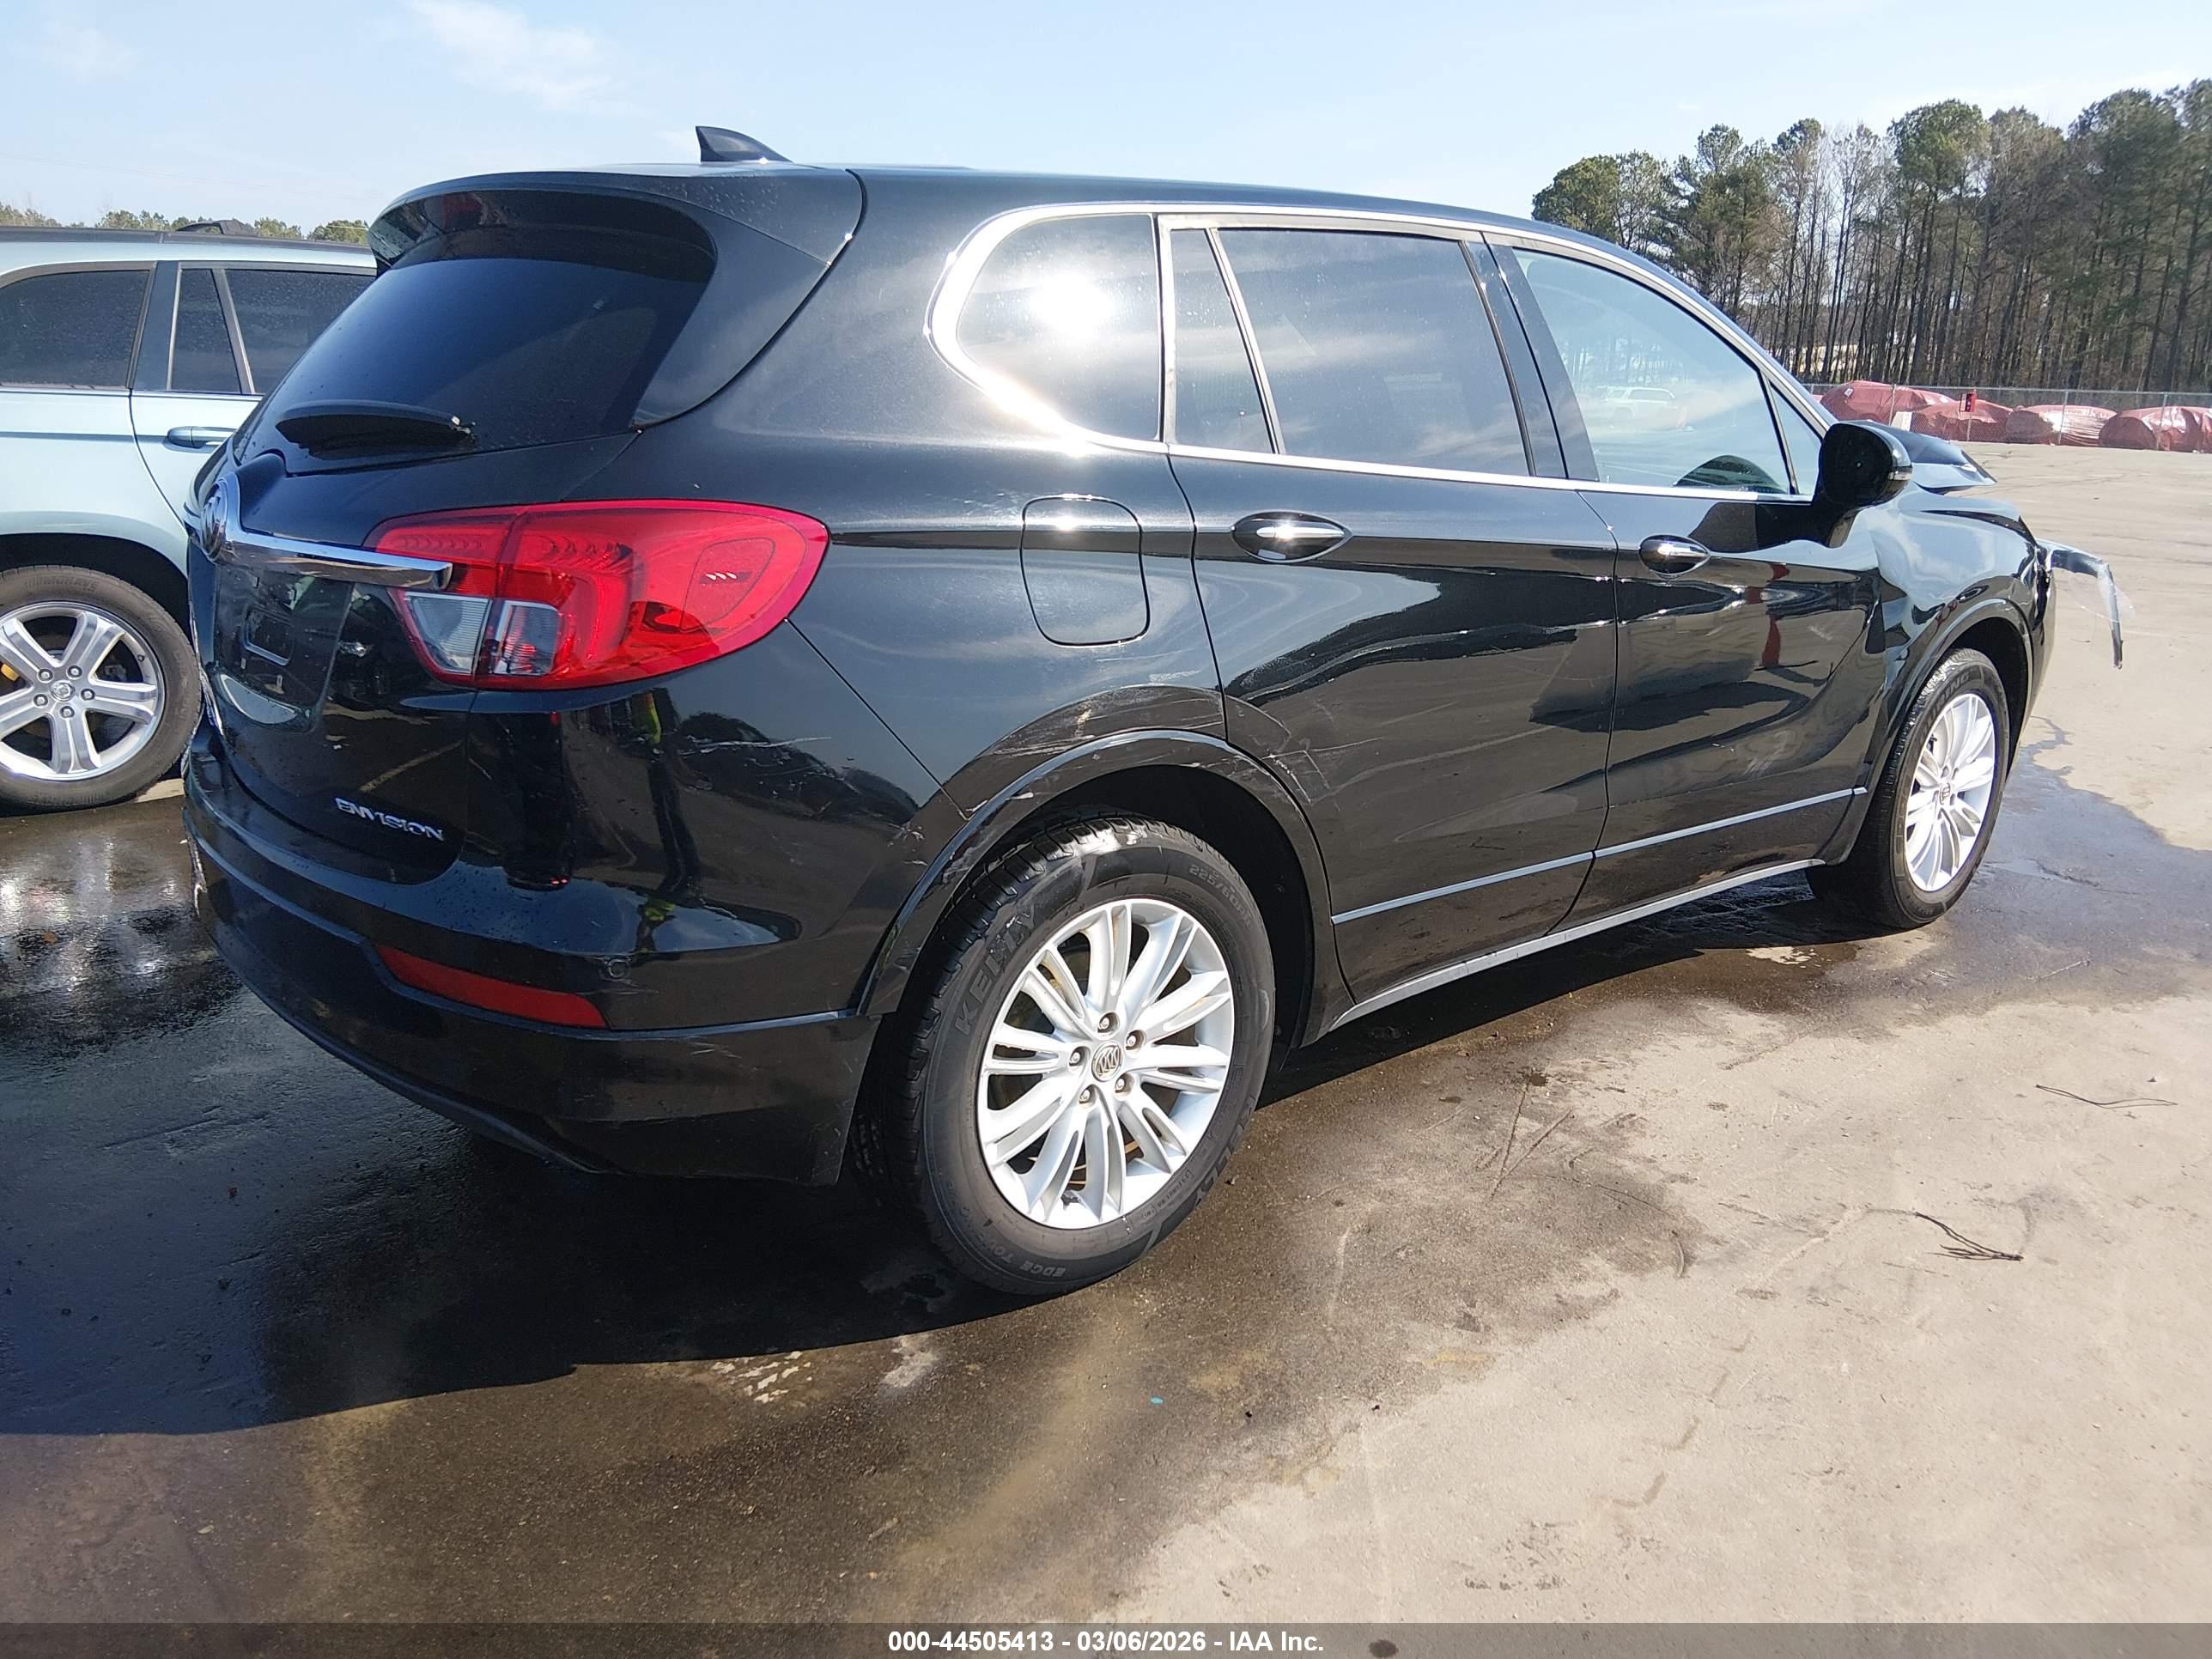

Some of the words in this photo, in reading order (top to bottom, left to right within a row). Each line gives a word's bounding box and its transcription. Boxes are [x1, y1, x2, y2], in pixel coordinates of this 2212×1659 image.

[335, 798, 444, 841] ENVISION
[954, 911, 1033, 1036] KELLY
[1019, 1260, 1066, 1278] EDGE
